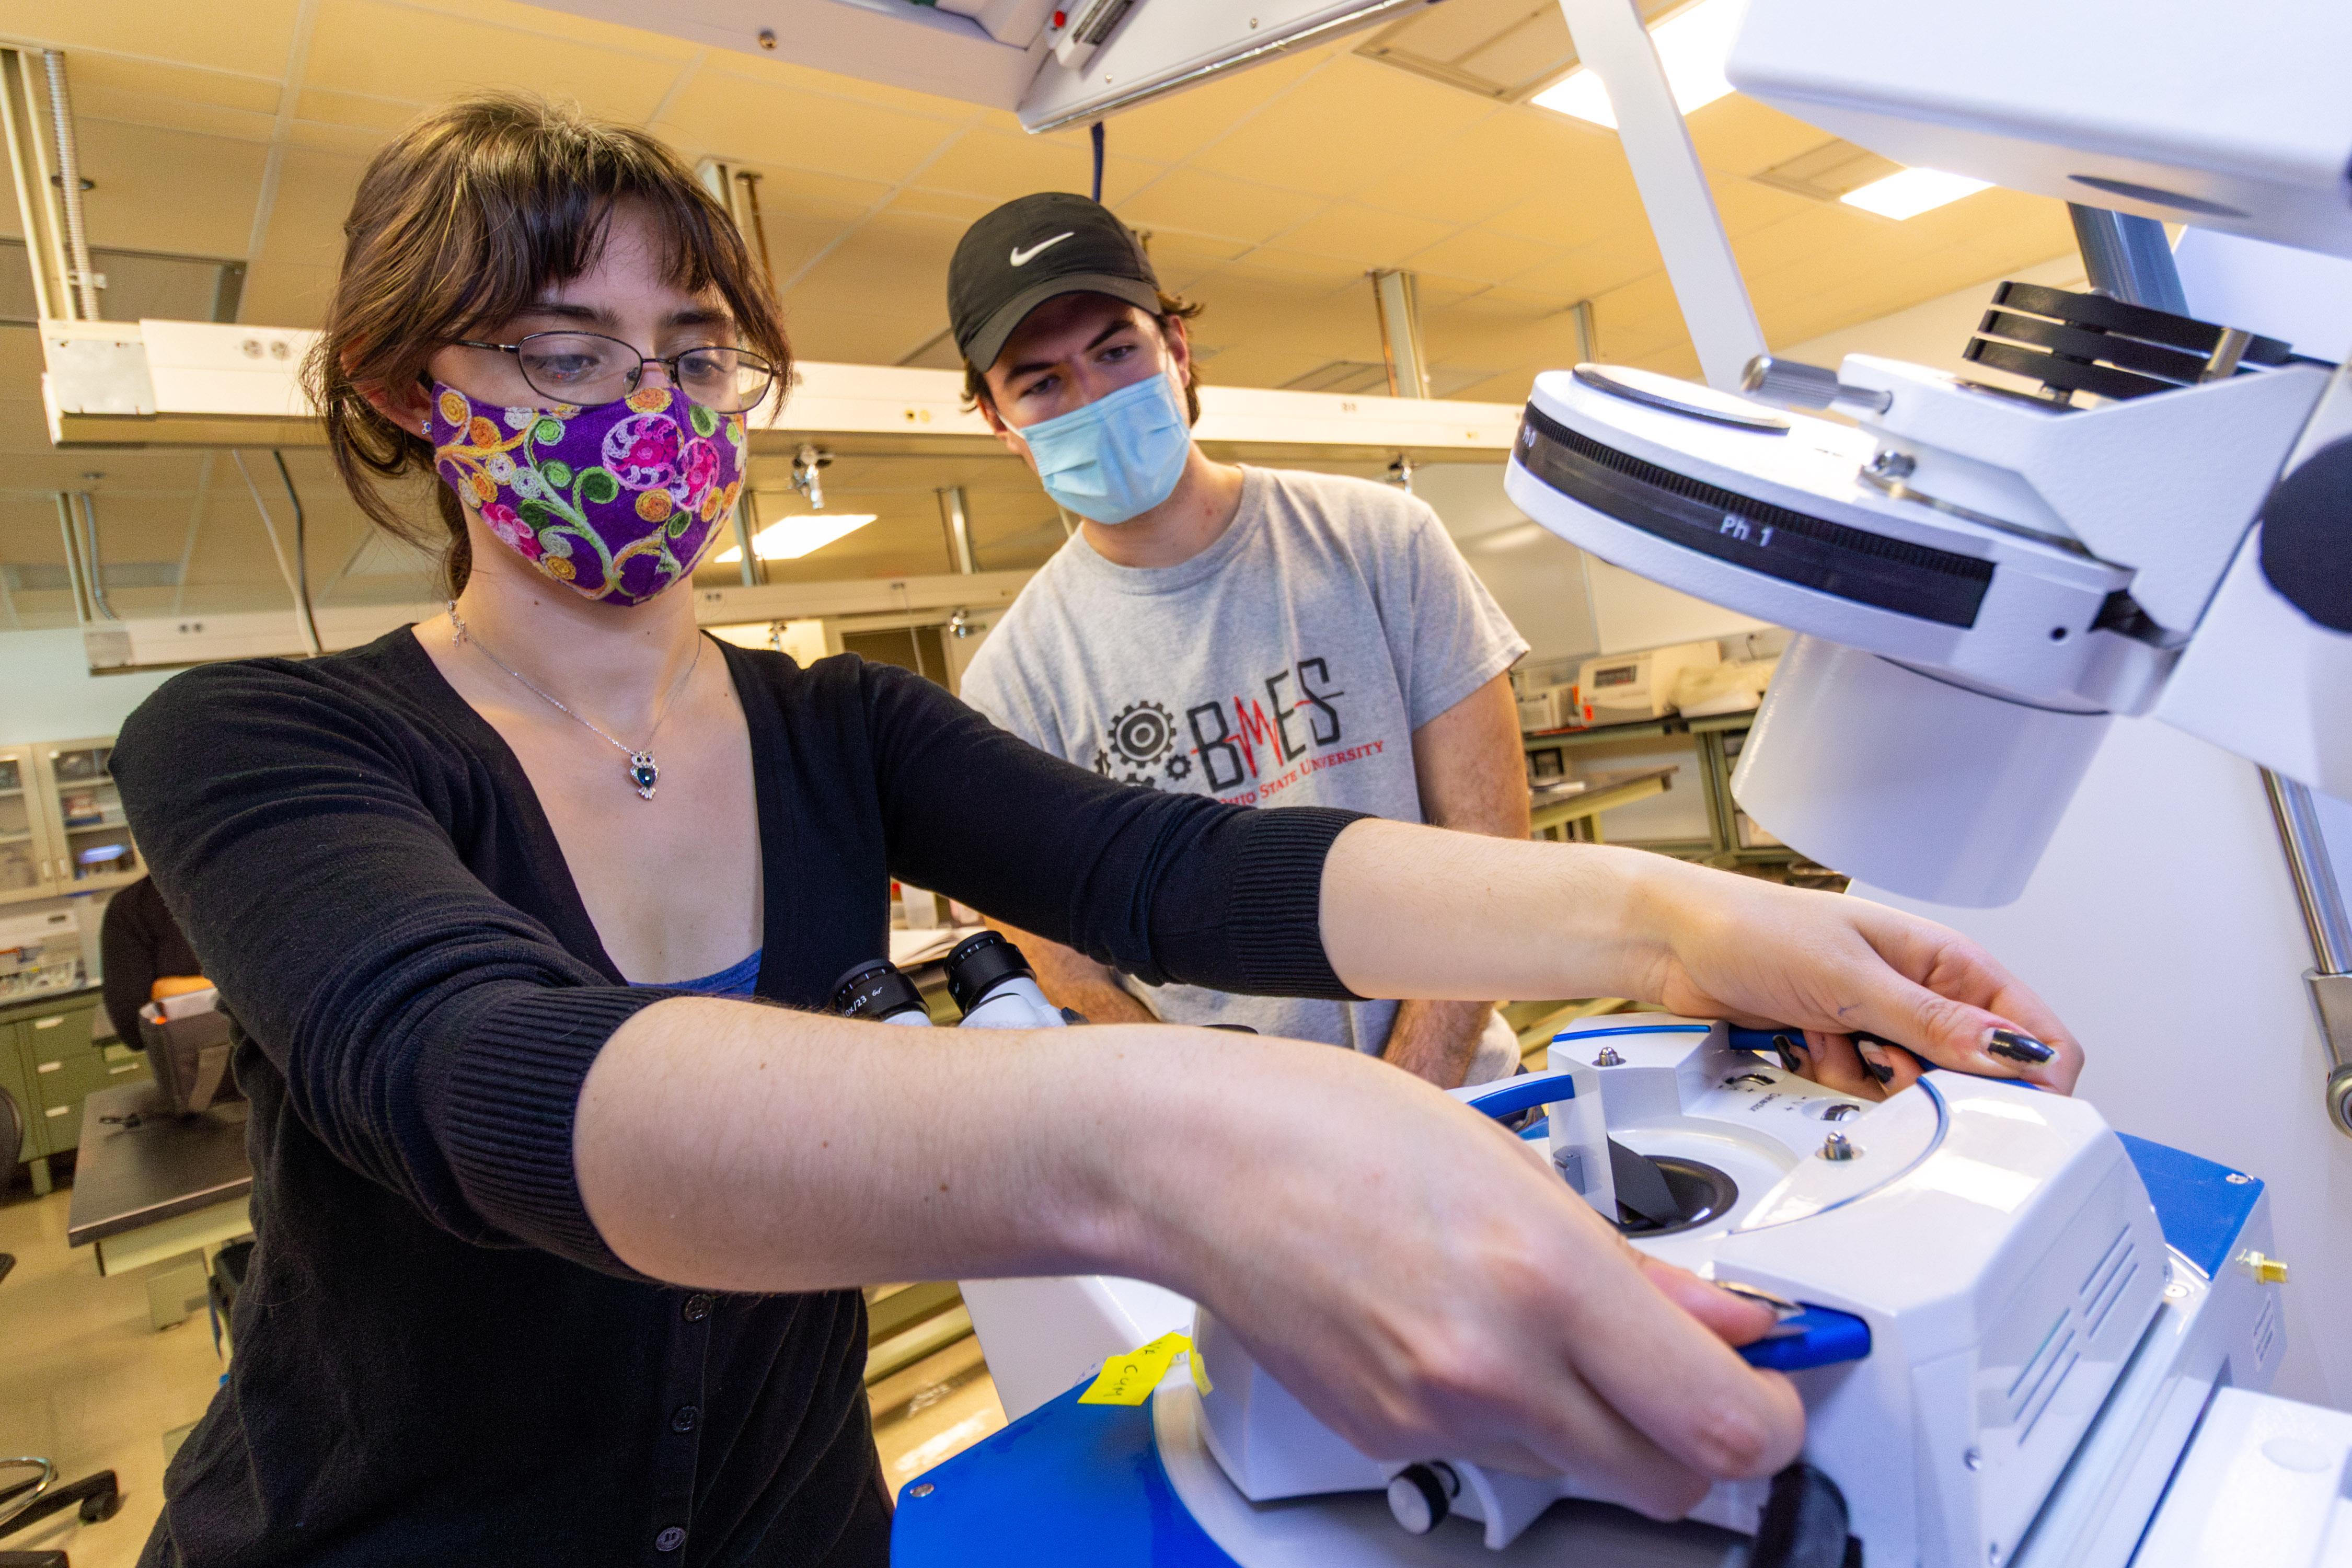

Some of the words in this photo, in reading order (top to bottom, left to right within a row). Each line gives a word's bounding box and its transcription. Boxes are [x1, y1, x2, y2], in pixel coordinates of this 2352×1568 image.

[1720, 514, 1750, 541] Ph
[1759, 525, 1773, 547] 1
[1187, 658, 1343, 793] BMES
[1259, 770, 1298, 799] STATE
[845, 995, 867, 1017] 0x/23
